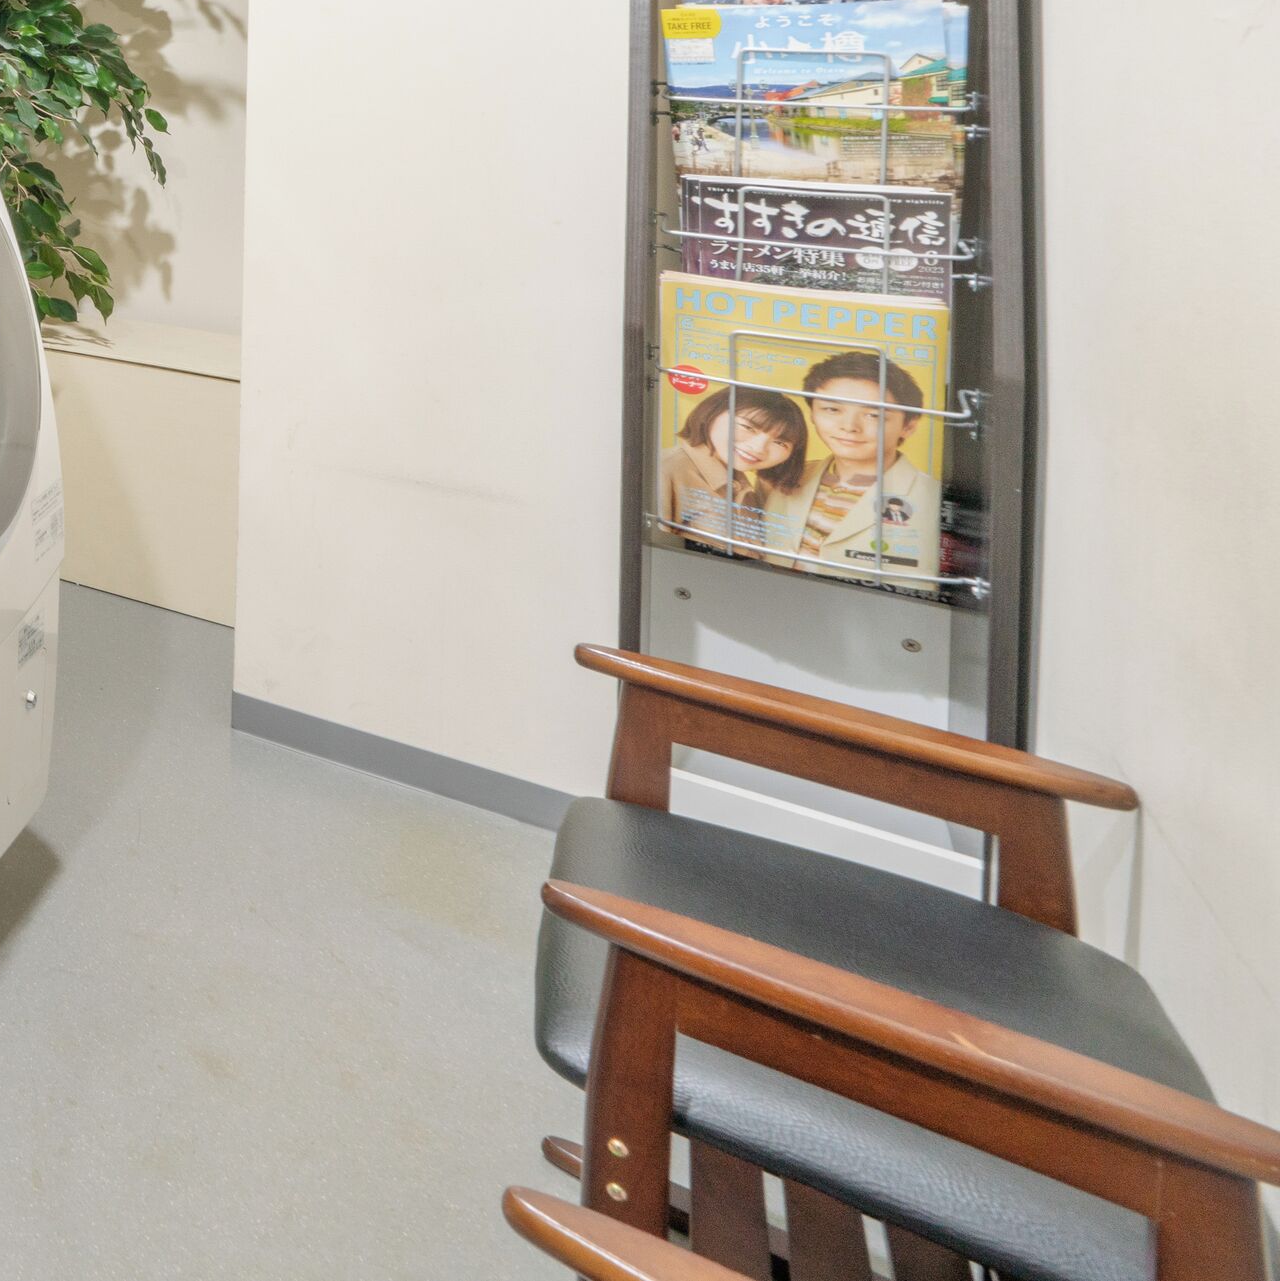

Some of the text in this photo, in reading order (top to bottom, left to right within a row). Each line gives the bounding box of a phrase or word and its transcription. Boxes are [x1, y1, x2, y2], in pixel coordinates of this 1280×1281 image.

[667, 21, 712, 31] TAKE FREE
[755, 13, 836, 28] ようこそ
[711, 239, 846, 268] ラーメン特集
[675, 287, 939, 340] HOT PEPPER
